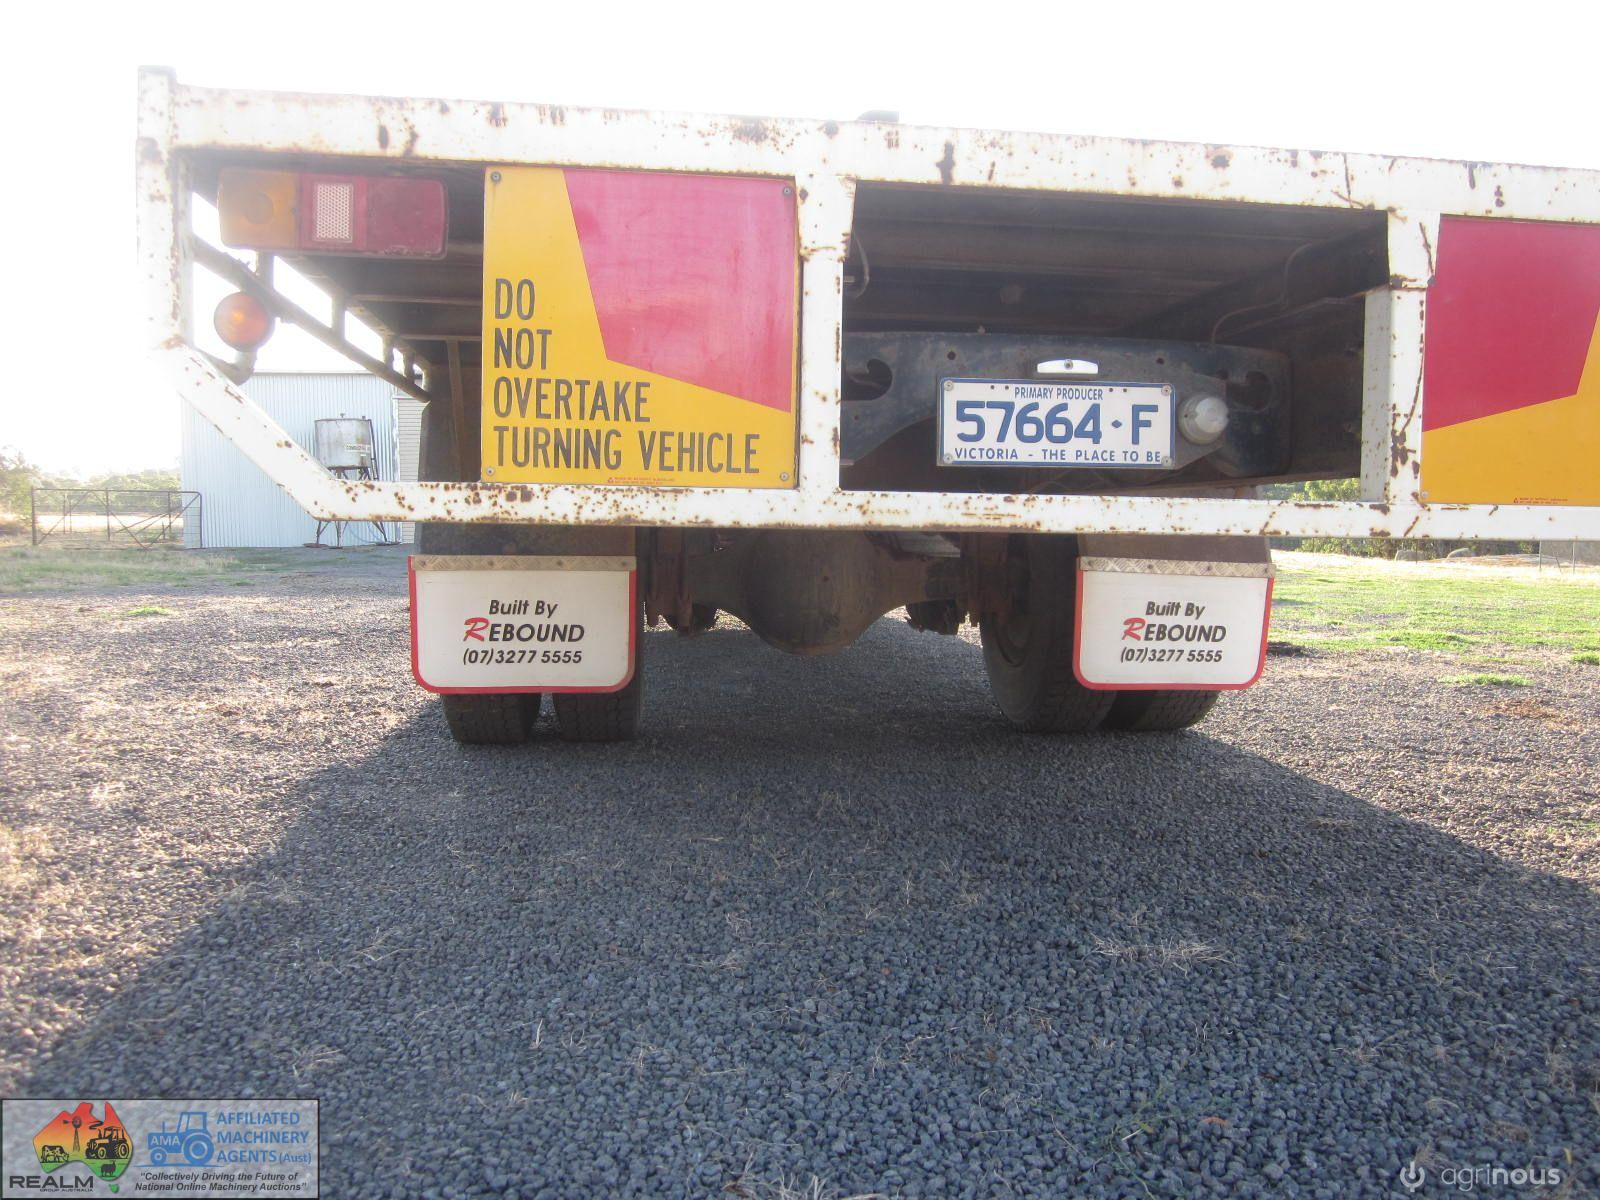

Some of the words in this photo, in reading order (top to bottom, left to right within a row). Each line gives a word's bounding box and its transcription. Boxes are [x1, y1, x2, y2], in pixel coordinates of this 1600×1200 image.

[494, 278, 536, 321] DO
[493, 327, 553, 370] NOT
[493, 376, 651, 423] OVERTAKE
[1014, 386, 1053, 400] PRIMARY
[1056, 387, 1104, 401] PRODUCER
[493, 425, 622, 471] TURNING
[638, 430, 760, 474] VEHICLE
[954, 447, 1018, 461] VICTORIA
[1042, 448, 1066, 461] THE
[1075, 449, 1116, 462] PLACE
[1122, 450, 1139, 462] TO
[1146, 451, 1161, 463] BE
[489, 600, 530, 616] Built
[534, 600, 558, 618] By
[1145, 601, 1181, 616] Built
[1185, 602, 1205, 620] By
[463, 617, 585, 643] REBOUND
[1121, 617, 1226, 643] REBOUND
[541, 650, 582, 664] 5555
[1186, 649, 1223, 663] 5555
